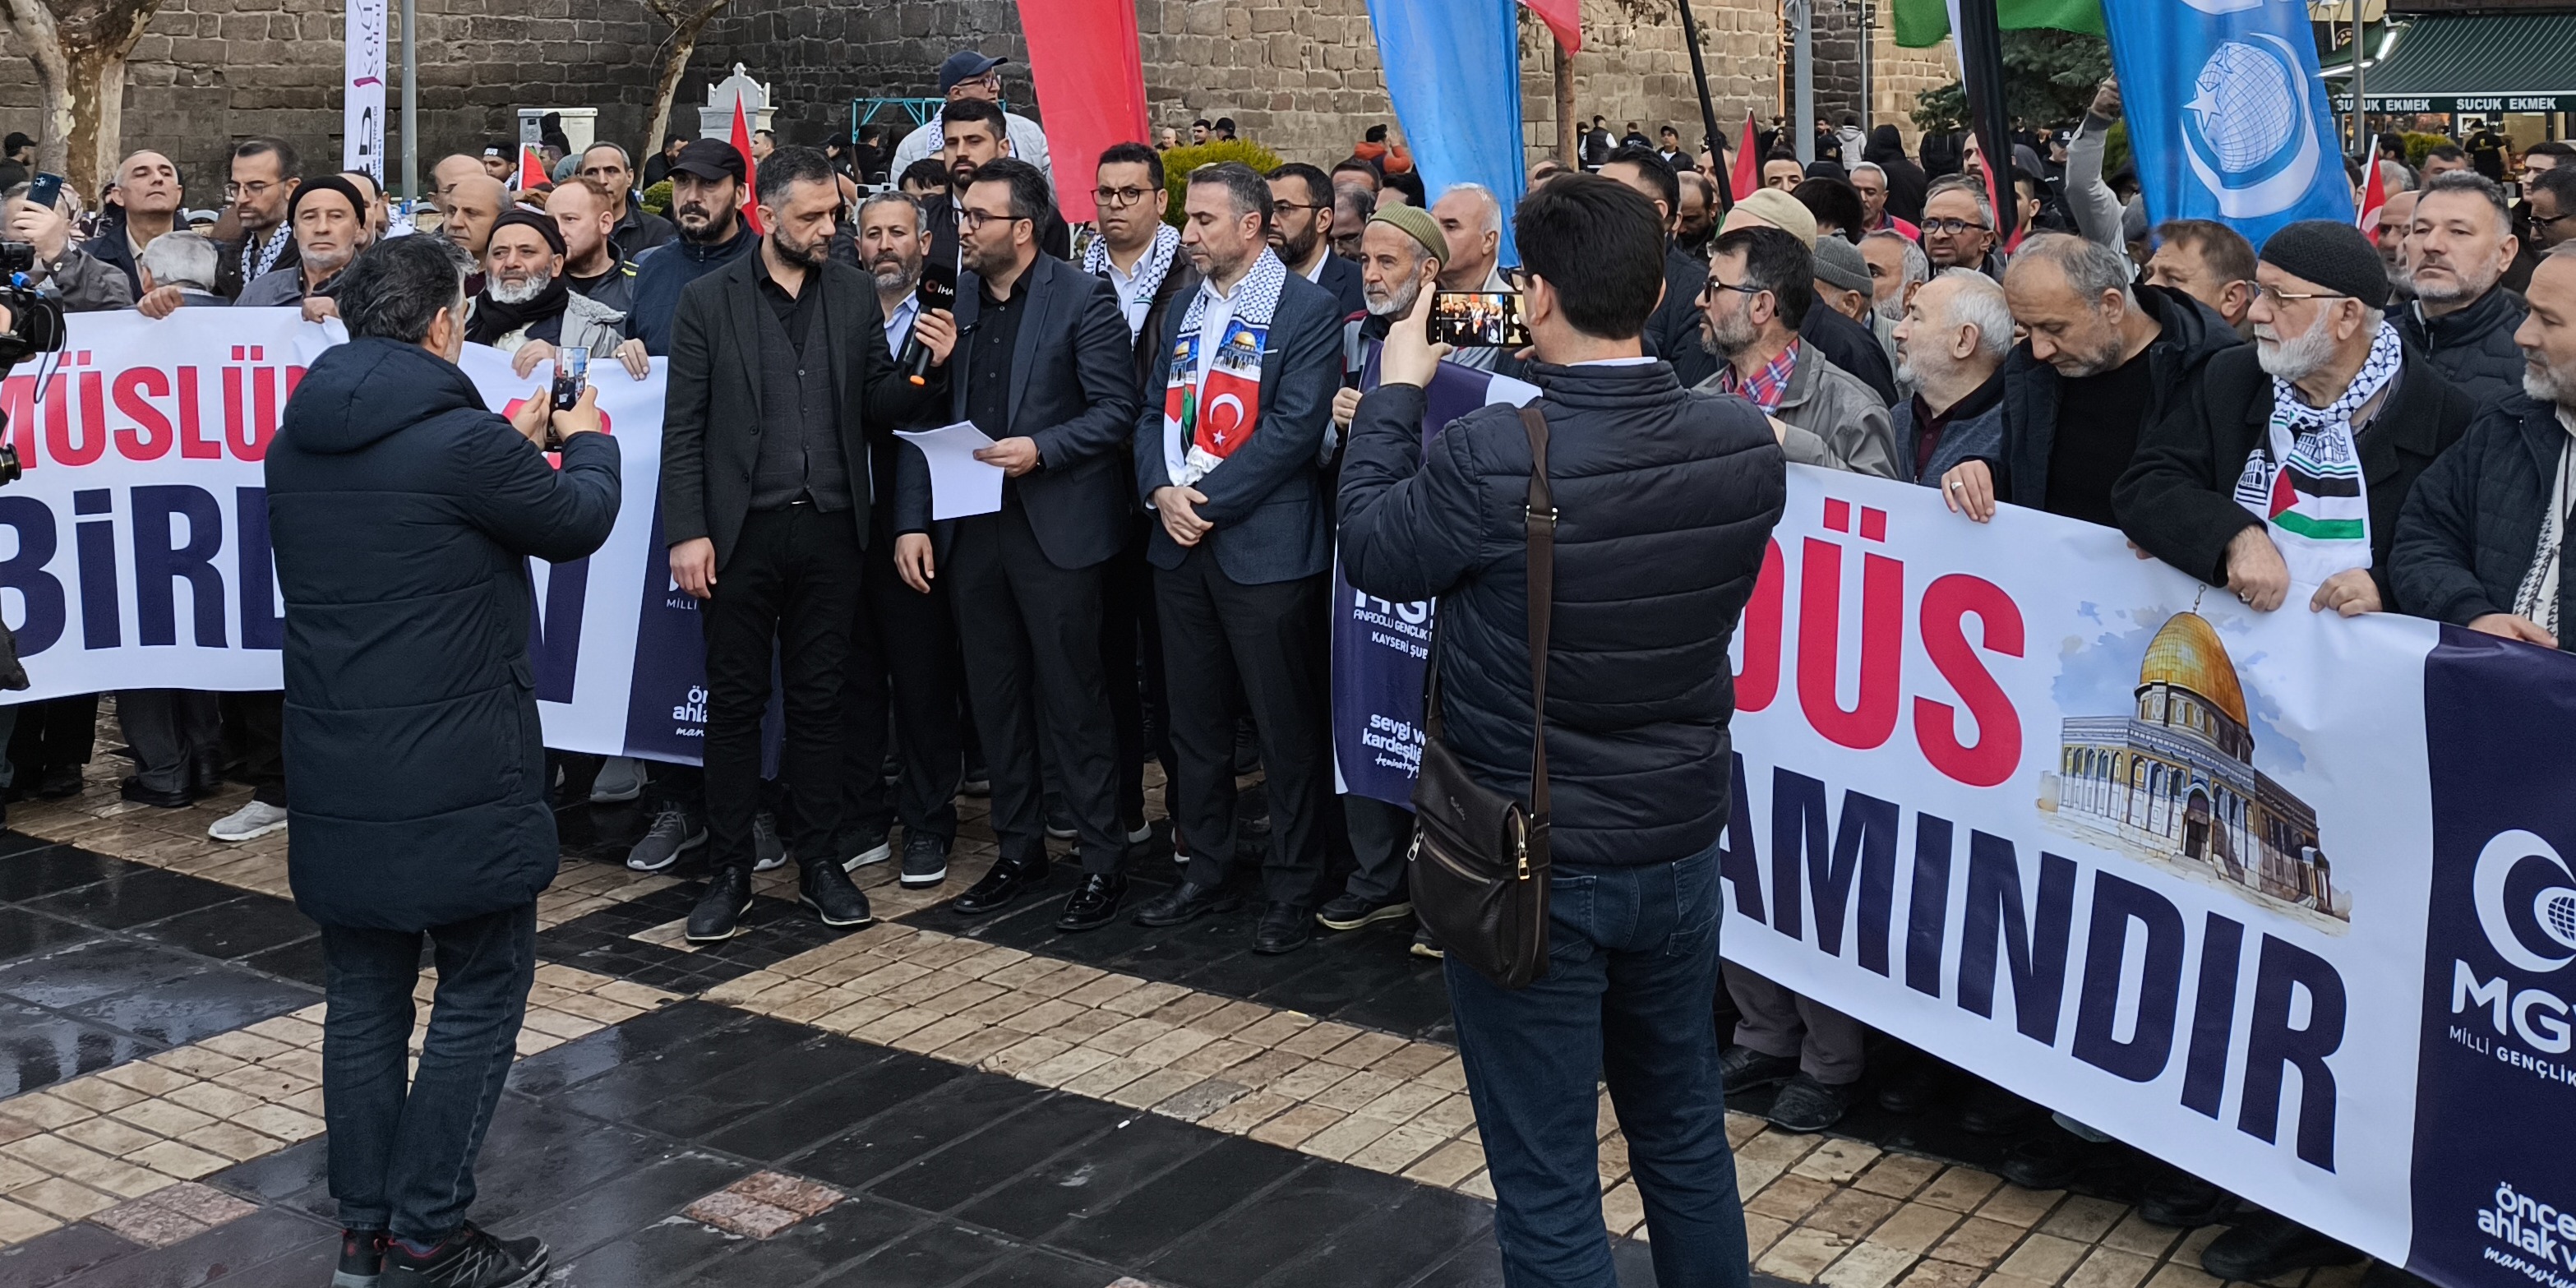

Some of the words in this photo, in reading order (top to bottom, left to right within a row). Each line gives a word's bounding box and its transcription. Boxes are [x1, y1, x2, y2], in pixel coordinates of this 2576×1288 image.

[2337, 99, 2380, 111] SUUK
[2385, 99, 2431, 111] EKMEK
[2456, 98, 2502, 110] SUCUK
[2509, 97, 2556, 110] EKMEK
[1353, 609, 1394, 628] ANADOLU
[1371, 631, 1410, 653] KAYSERİ
[1369, 713, 1411, 741] sevgi
[2452, 958, 2576, 1054] MG
[2449, 1025, 2489, 1055] MİLLİ
[2496, 1046, 2576, 1087] GENÇLİK
[2495, 1181, 2576, 1241] önce
[2477, 1207, 2558, 1264] ahlak
